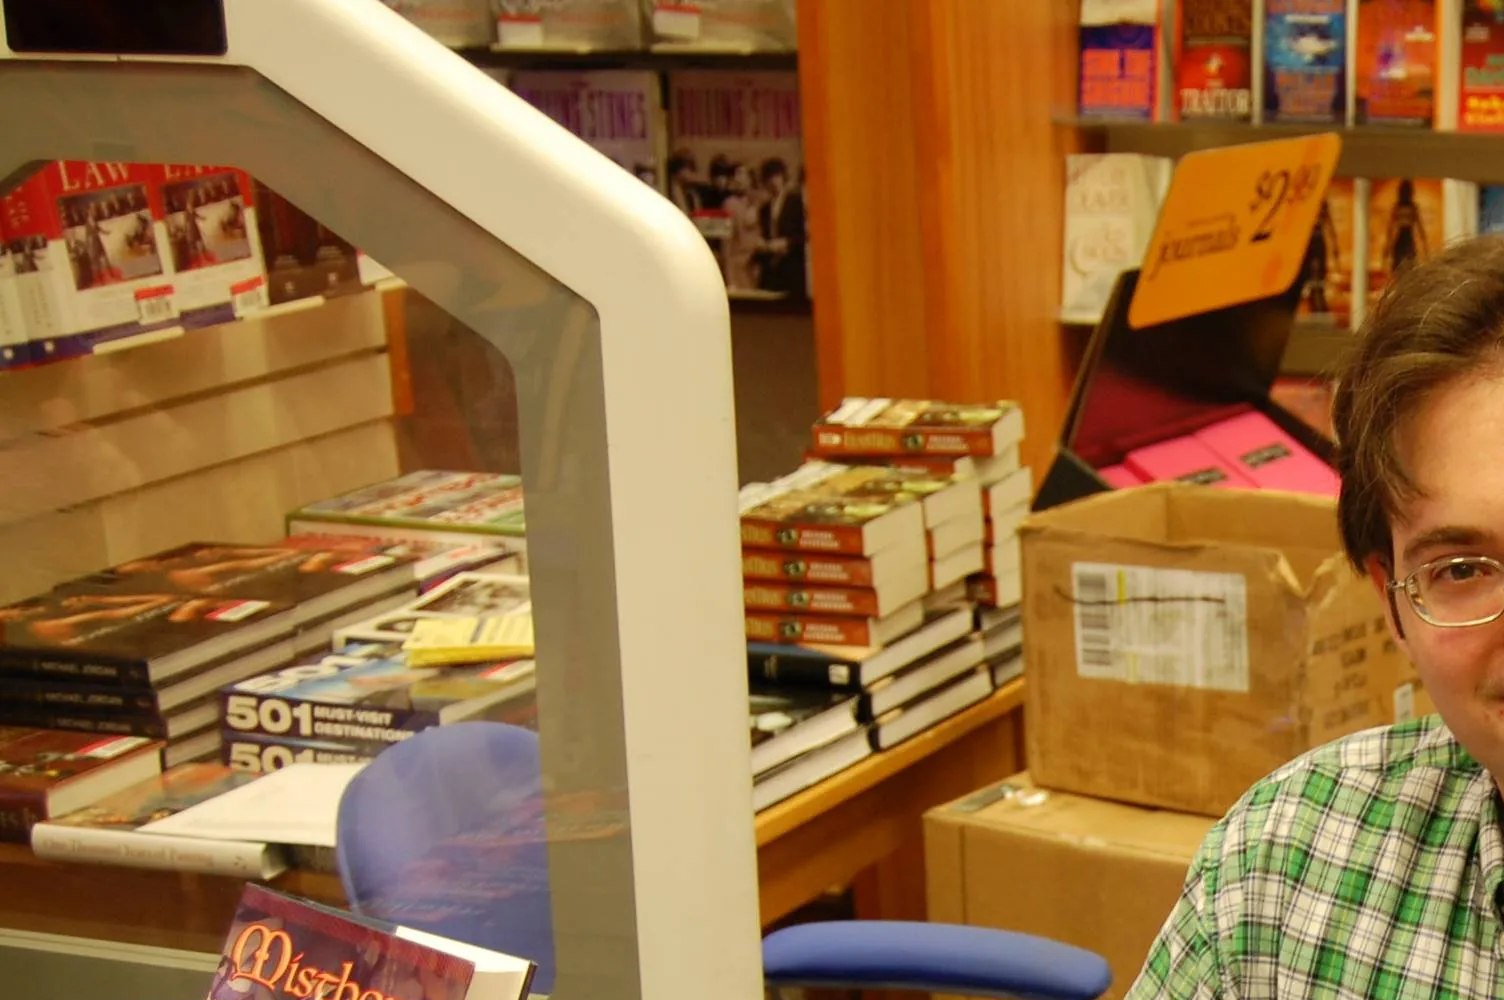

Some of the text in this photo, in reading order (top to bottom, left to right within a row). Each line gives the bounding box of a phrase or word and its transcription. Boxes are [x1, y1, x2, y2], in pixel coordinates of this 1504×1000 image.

[1178, 88, 1250, 113] TRAITOR
[226, 695, 314, 737] 501
[314, 704, 393, 726] MUST-VISIT
